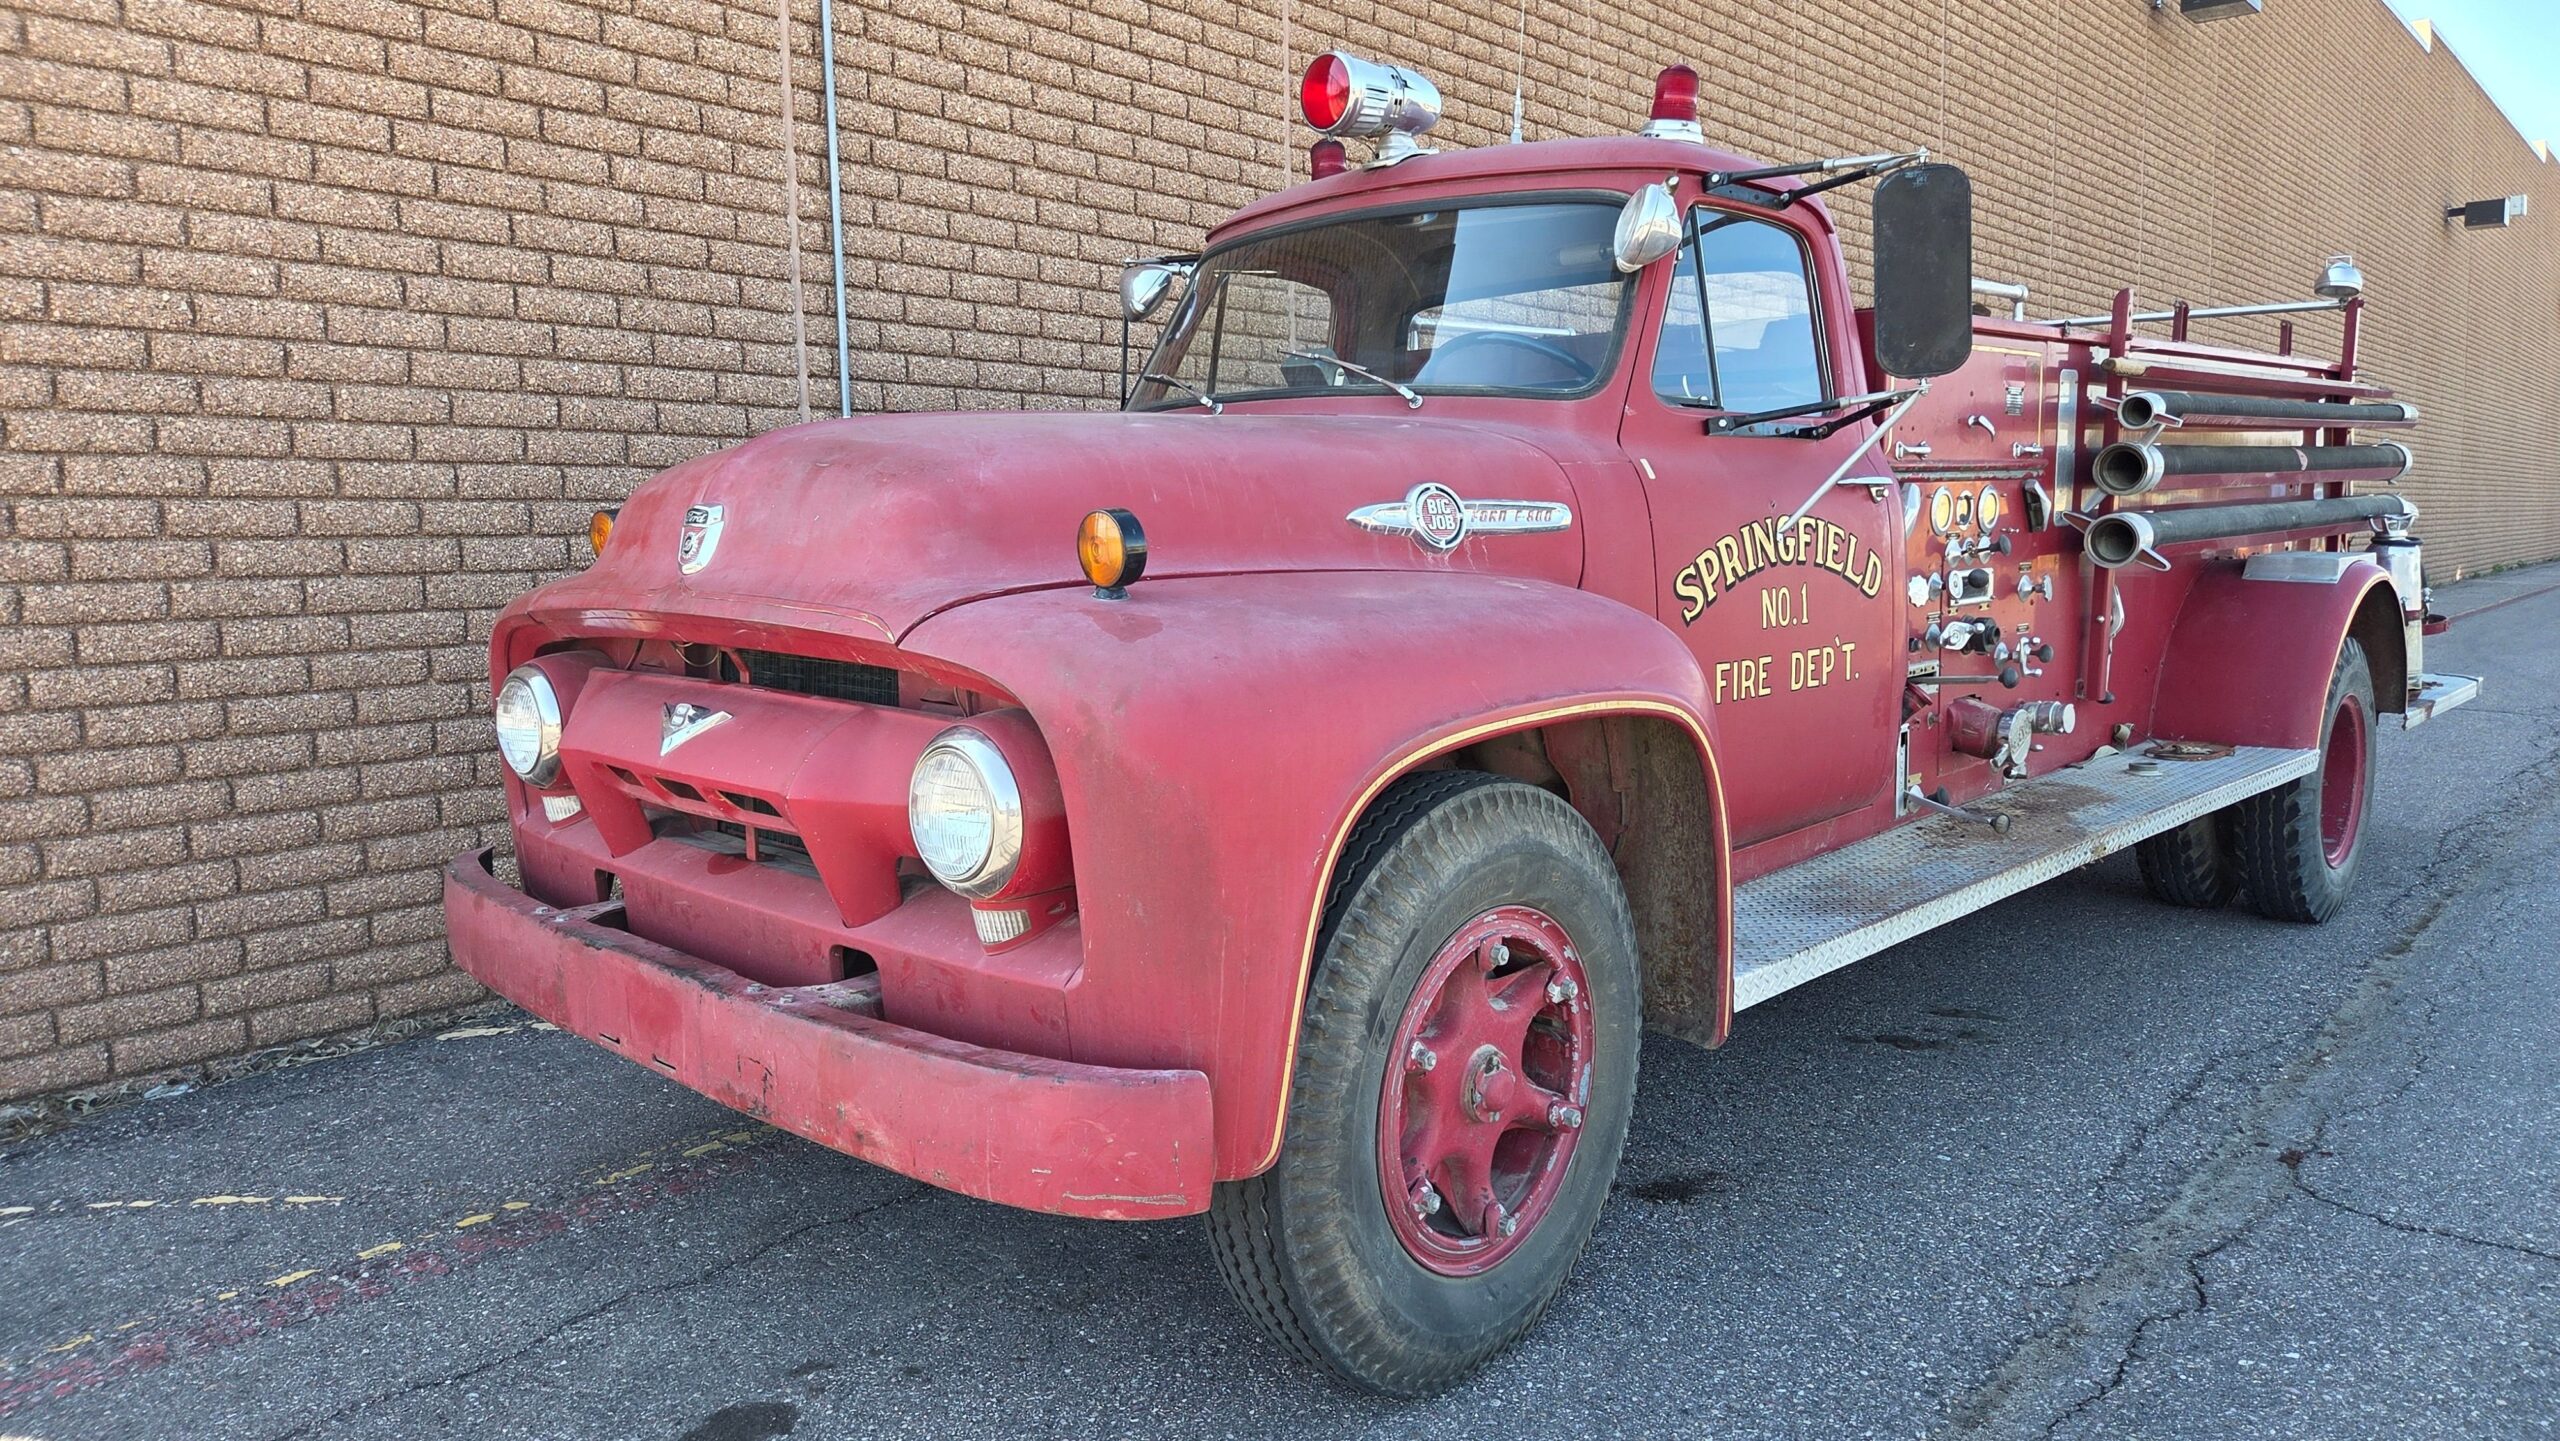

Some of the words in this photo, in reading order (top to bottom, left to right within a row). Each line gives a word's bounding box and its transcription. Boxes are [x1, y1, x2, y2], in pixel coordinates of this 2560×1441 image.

[1426, 498, 1452, 515] BIG
[687, 510, 708, 523] Ford
[1428, 515, 1456, 531] JOB
[1470, 509, 1507, 523] FORD
[1673, 514, 1883, 628] SPRINGFIELD
[1714, 655, 1773, 705] FIRE
[1789, 634, 1861, 692] DEP'T.
